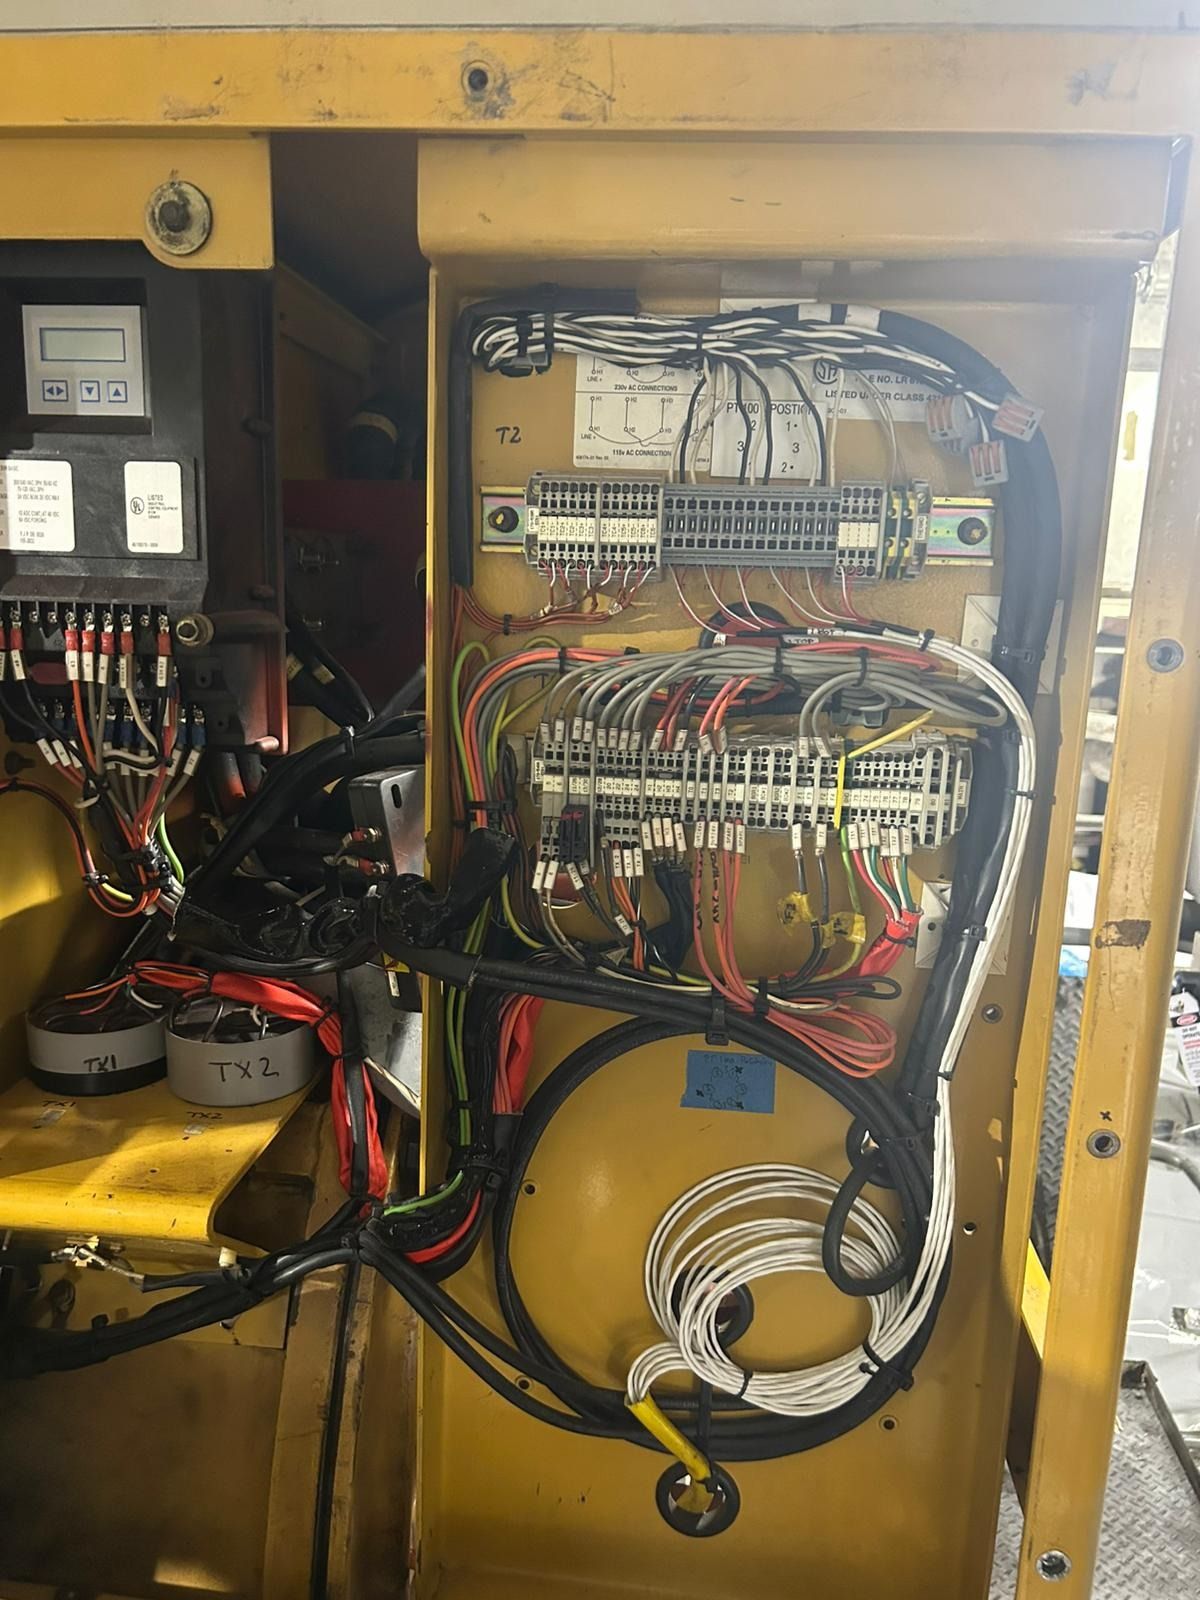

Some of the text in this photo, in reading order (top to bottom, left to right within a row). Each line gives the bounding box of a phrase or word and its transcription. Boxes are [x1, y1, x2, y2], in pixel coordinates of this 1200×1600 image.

[877, 374, 893, 384] NO.
[893, 394, 924, 402] CLASS
[496, 426, 522, 444] T2
[792, 442, 800, 454] 3
[781, 462, 788, 472] 2
[84, 1054, 118, 1072] TX1
[208, 1057, 280, 1082] TX2
[187, 1110, 224, 1120] TX2
